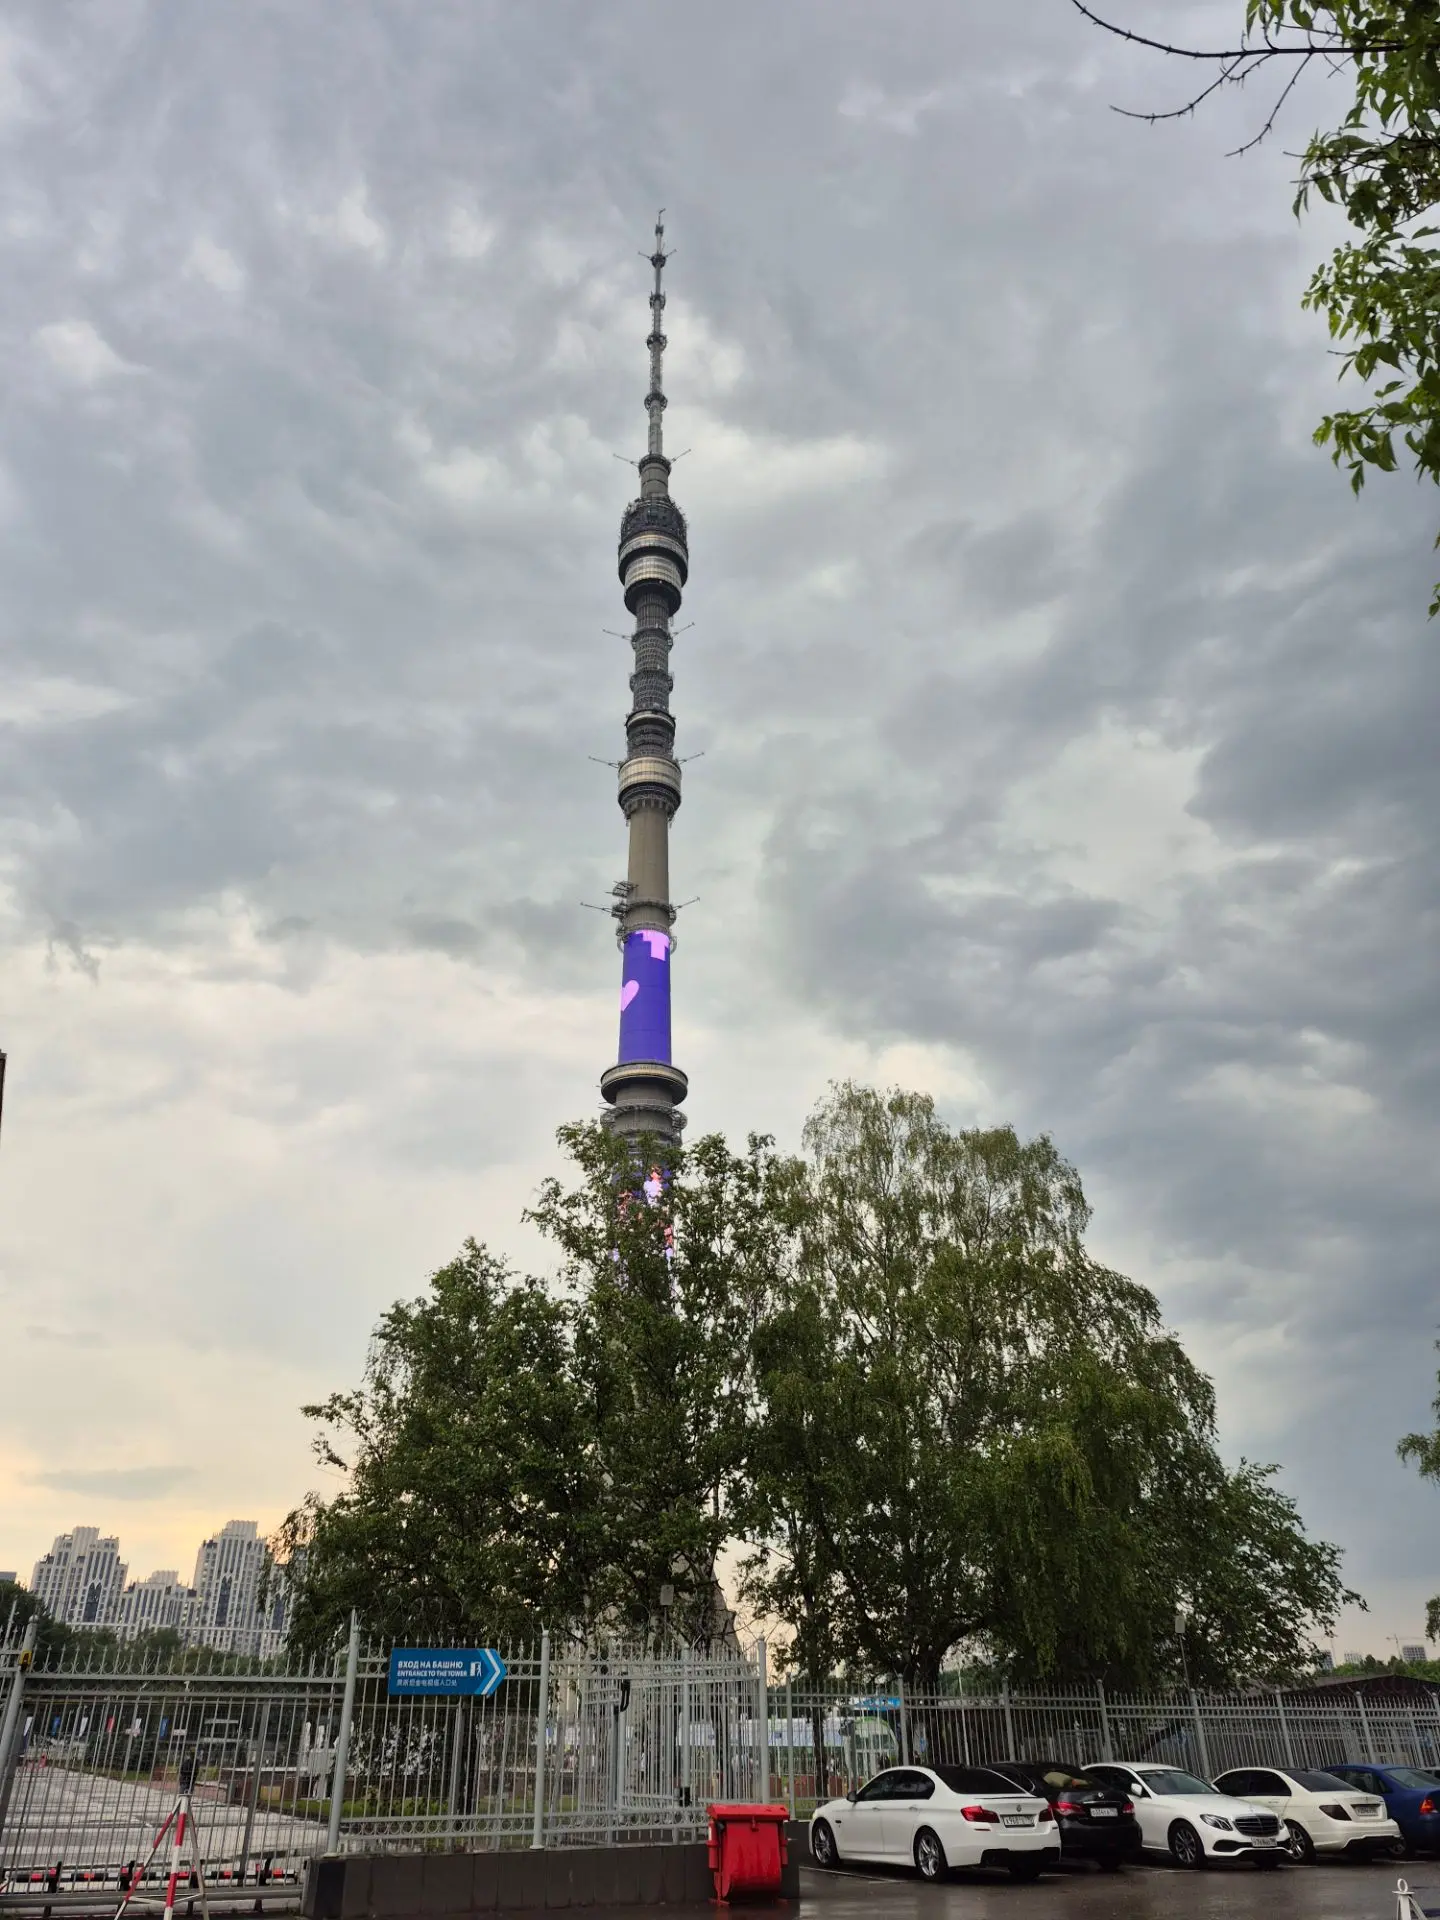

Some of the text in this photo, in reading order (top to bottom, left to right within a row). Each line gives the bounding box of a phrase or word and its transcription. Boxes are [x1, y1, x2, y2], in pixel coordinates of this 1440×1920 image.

[398, 1660, 463, 1669] ВХОД НА БАШНЮ
